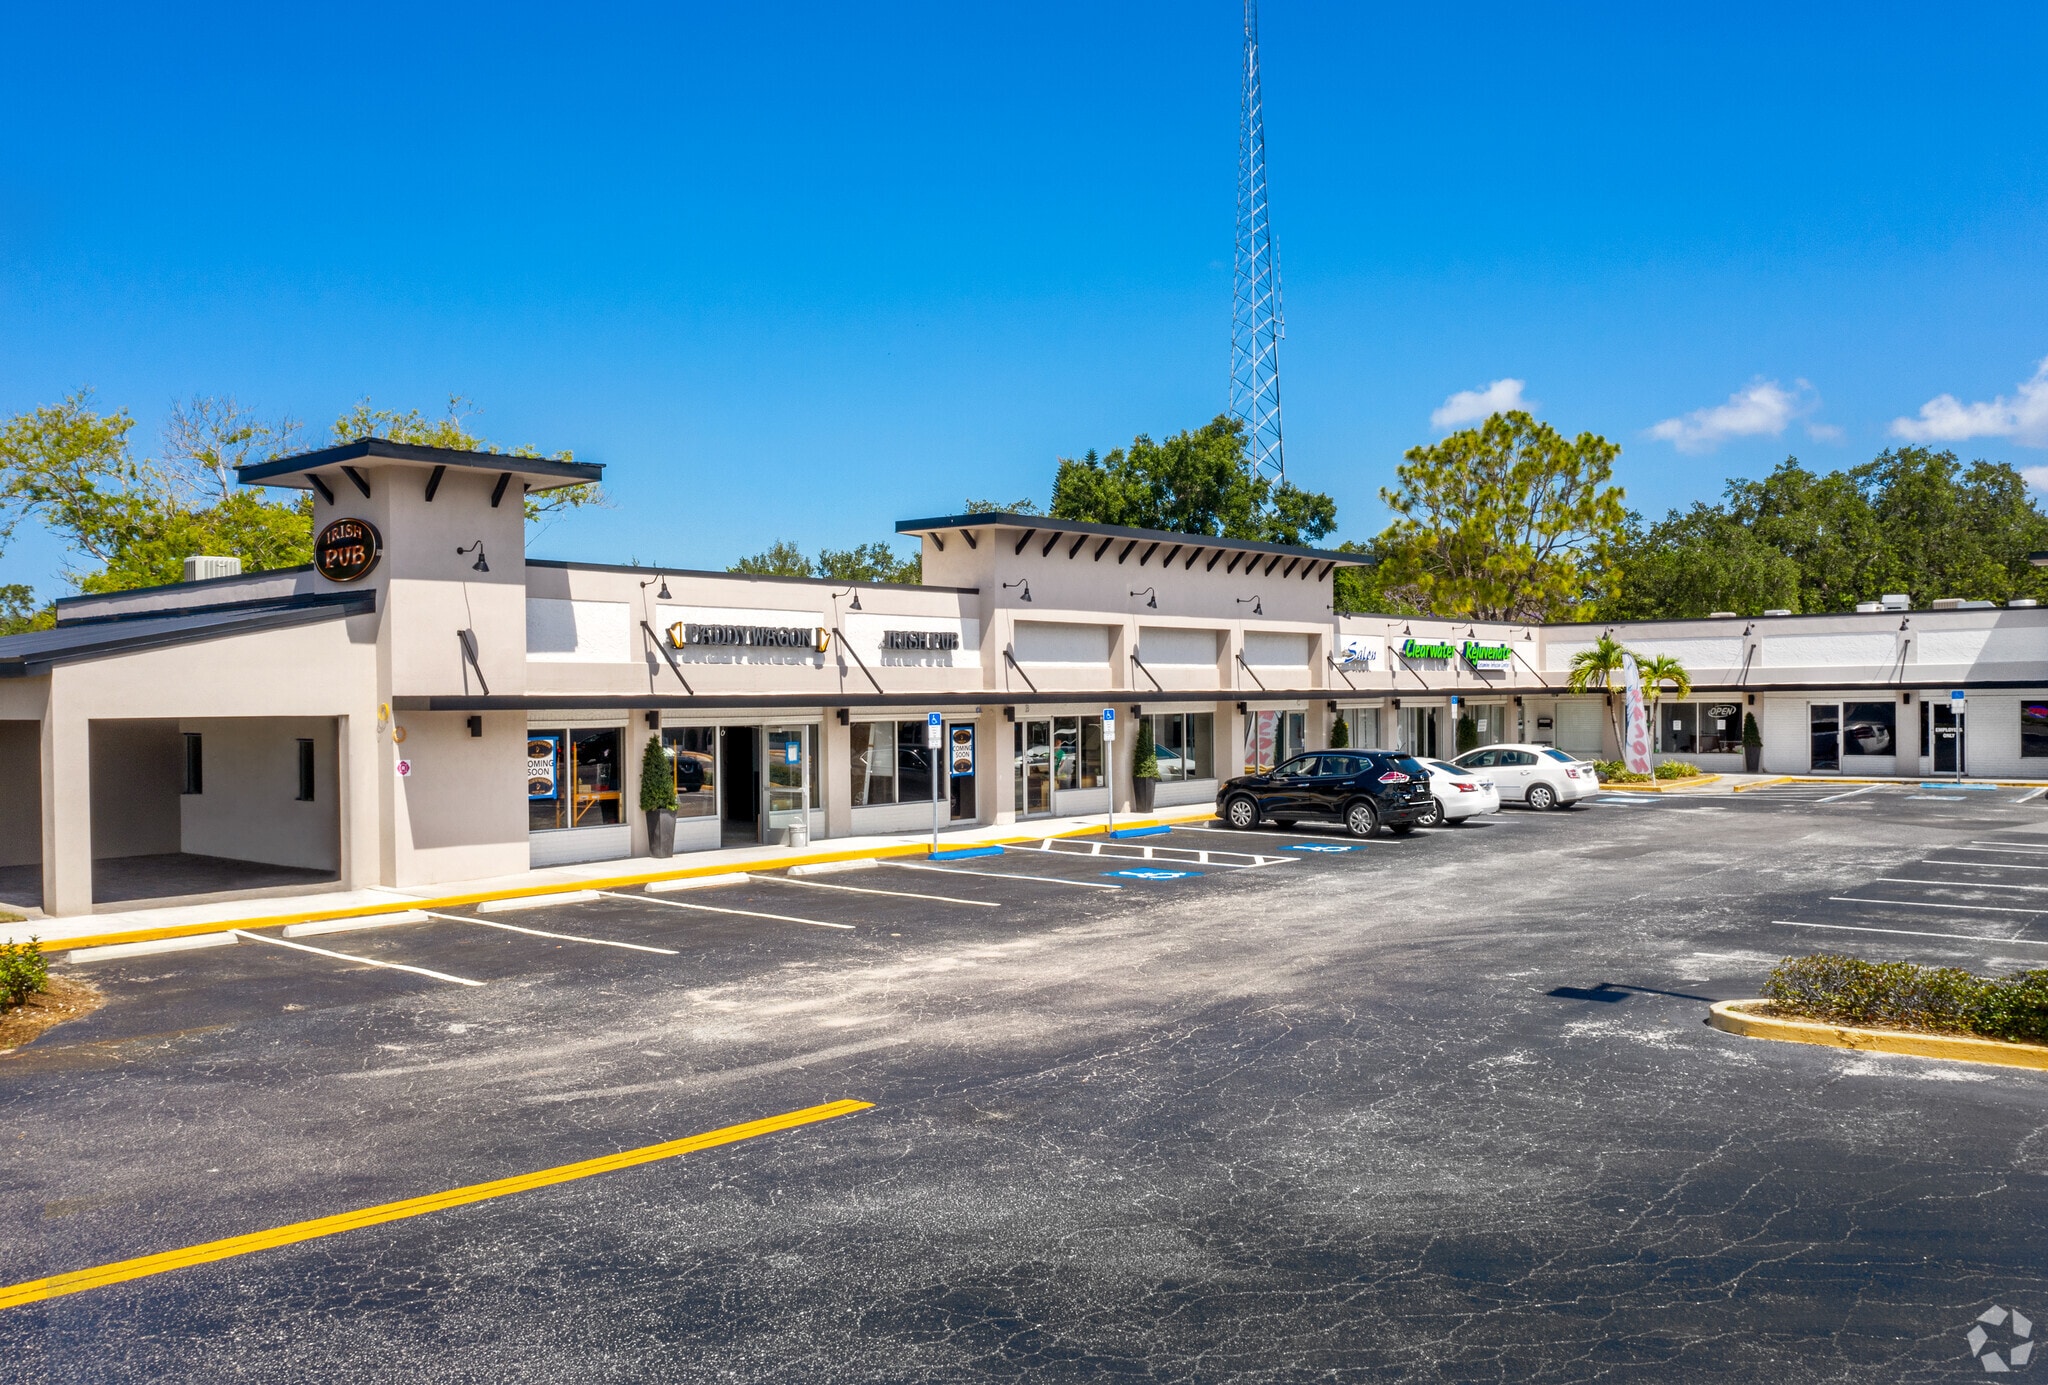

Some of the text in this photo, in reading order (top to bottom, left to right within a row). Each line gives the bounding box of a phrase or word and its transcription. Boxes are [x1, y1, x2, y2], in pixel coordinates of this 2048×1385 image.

[326, 524, 362, 544] IRISH
[324, 545, 366, 569] PUB
[686, 624, 812, 648] PADDY WAGON
[884, 630, 959, 650] IRISH PUB
[1403, 639, 1455, 659] Clearwater
[1463, 641, 1511, 666] Rejuvenate
[1710, 707, 1733, 715] OPEN
[527, 760, 554, 768] OMING
[527, 768, 550, 776] SOON
